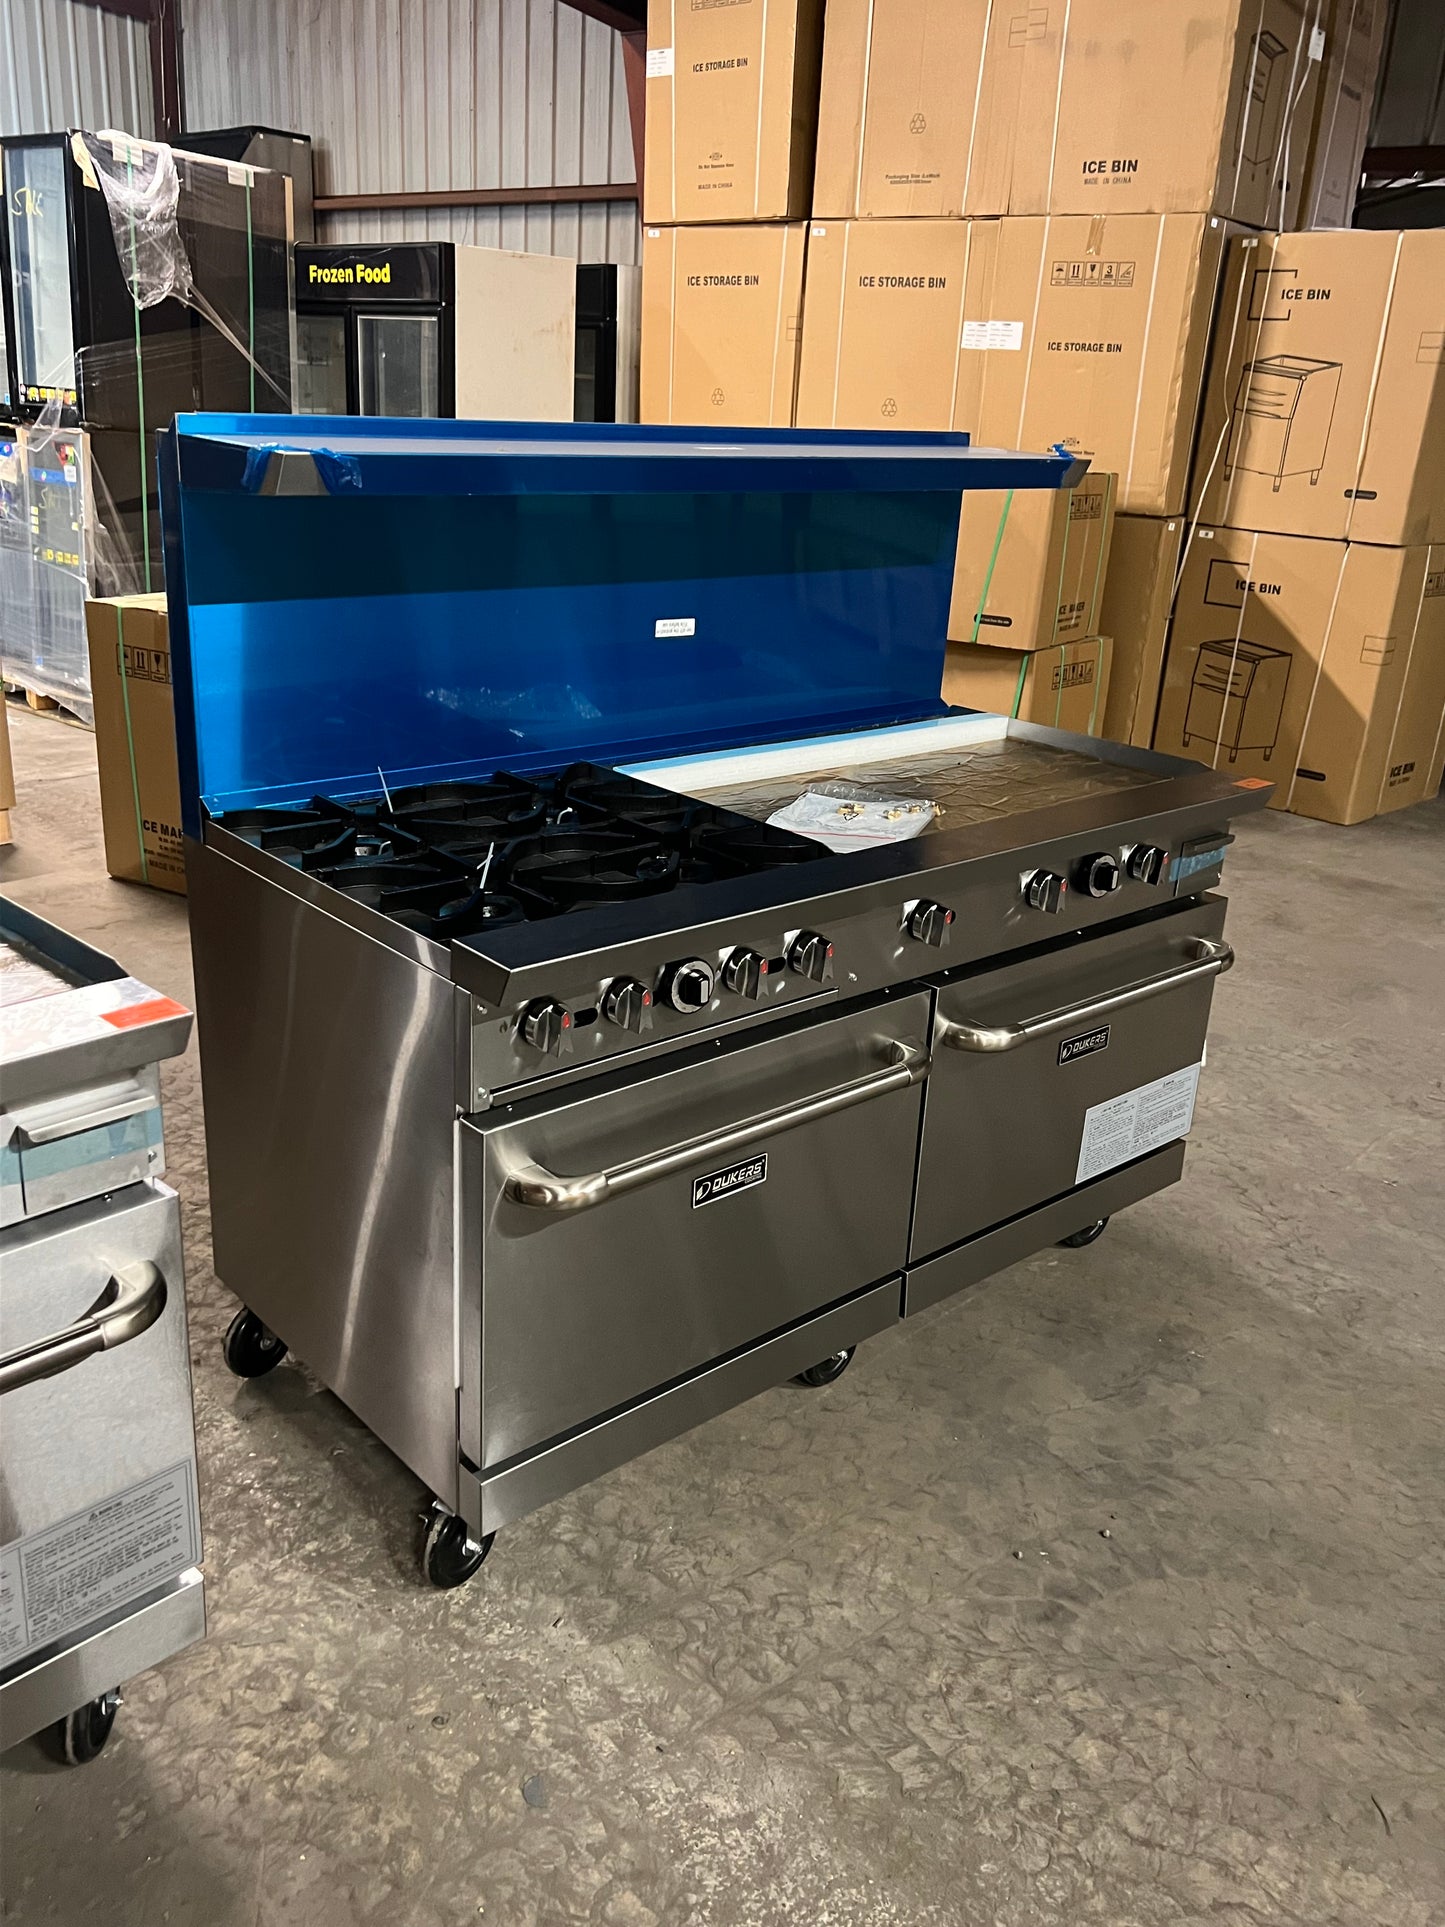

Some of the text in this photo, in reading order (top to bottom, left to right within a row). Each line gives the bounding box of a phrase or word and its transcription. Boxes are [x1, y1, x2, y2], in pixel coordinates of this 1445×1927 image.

[692, 58, 748, 73] ICE STORAGE BIN
[1082, 159, 1138, 174] ICE BIN
[1112, 176, 1131, 184] CHINA
[308, 262, 391, 283] Frozen Food
[687, 275, 759, 286] ICE STORAGE BIN
[859, 276, 946, 288] ICE STORAGE BIN
[1281, 289, 1331, 300] ICE BIN
[1047, 342, 1122, 353] ICE STORAGE BIN
[1235, 580, 1282, 596] ICE BIN
[1390, 761, 1415, 778] ICE BIN
[1072, 1032, 1107, 1052] DUKERS
[712, 1161, 763, 1191] DUKERS
